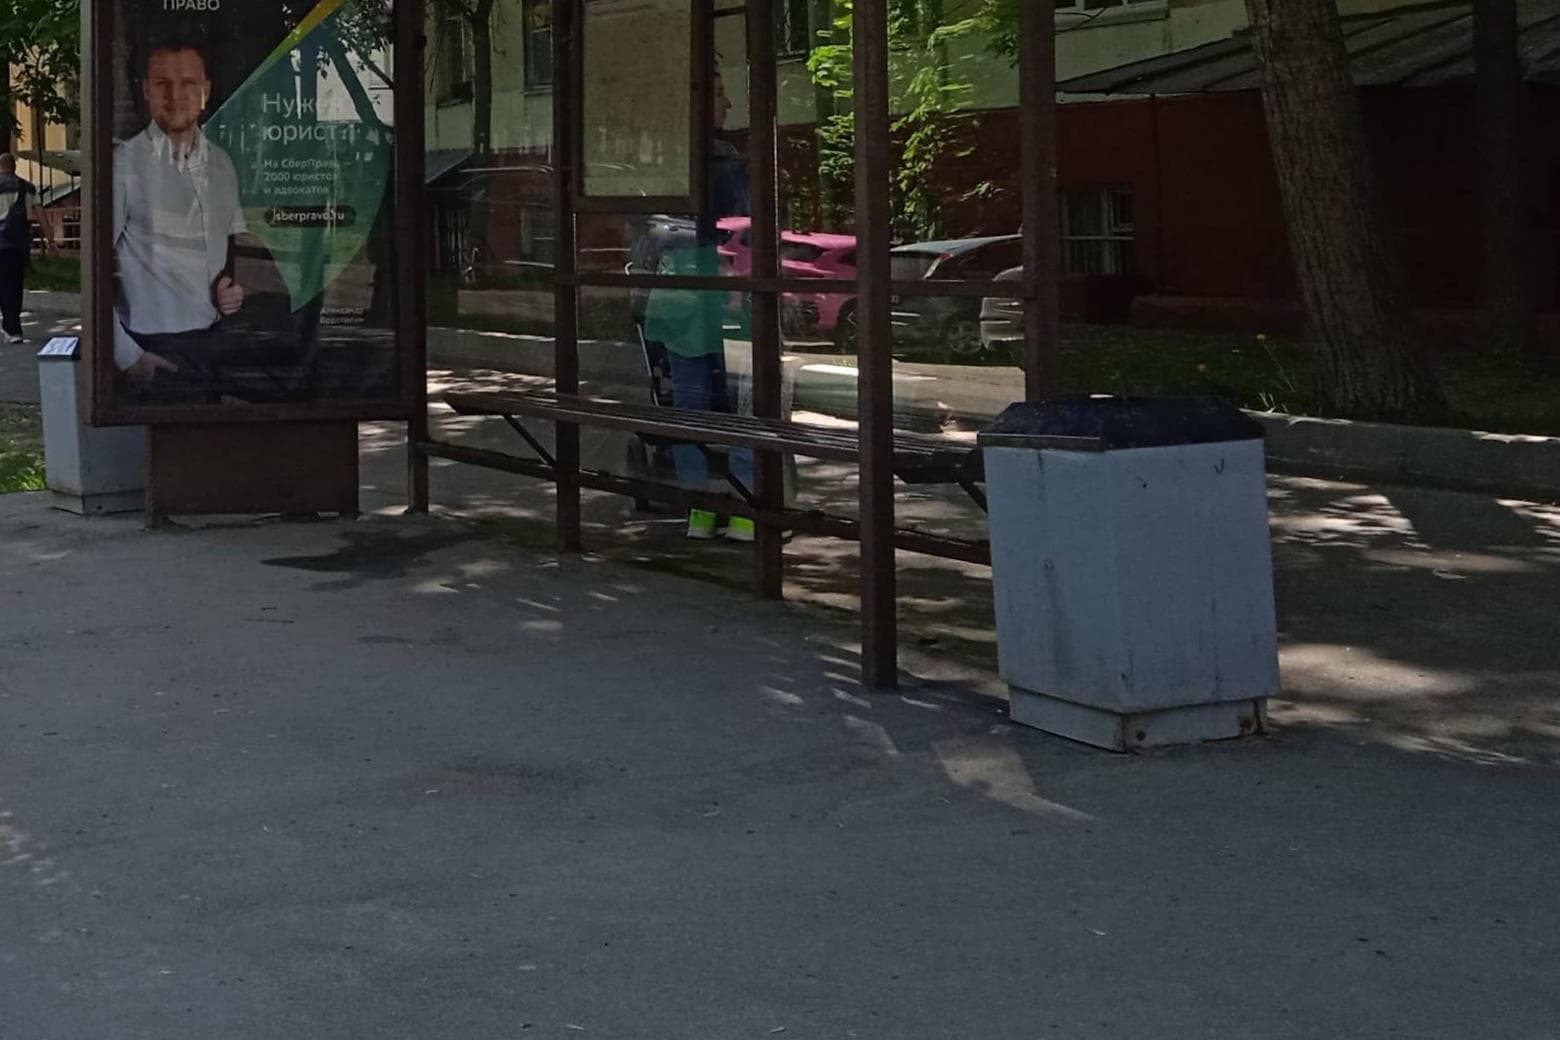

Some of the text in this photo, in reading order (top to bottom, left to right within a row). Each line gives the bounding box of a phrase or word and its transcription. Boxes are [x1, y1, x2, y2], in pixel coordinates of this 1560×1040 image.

[263, 93, 342, 118] Нуж
[264, 159, 278, 168] На
[264, 172, 290, 181] 2000
[274, 186, 329, 196] адвокатов
